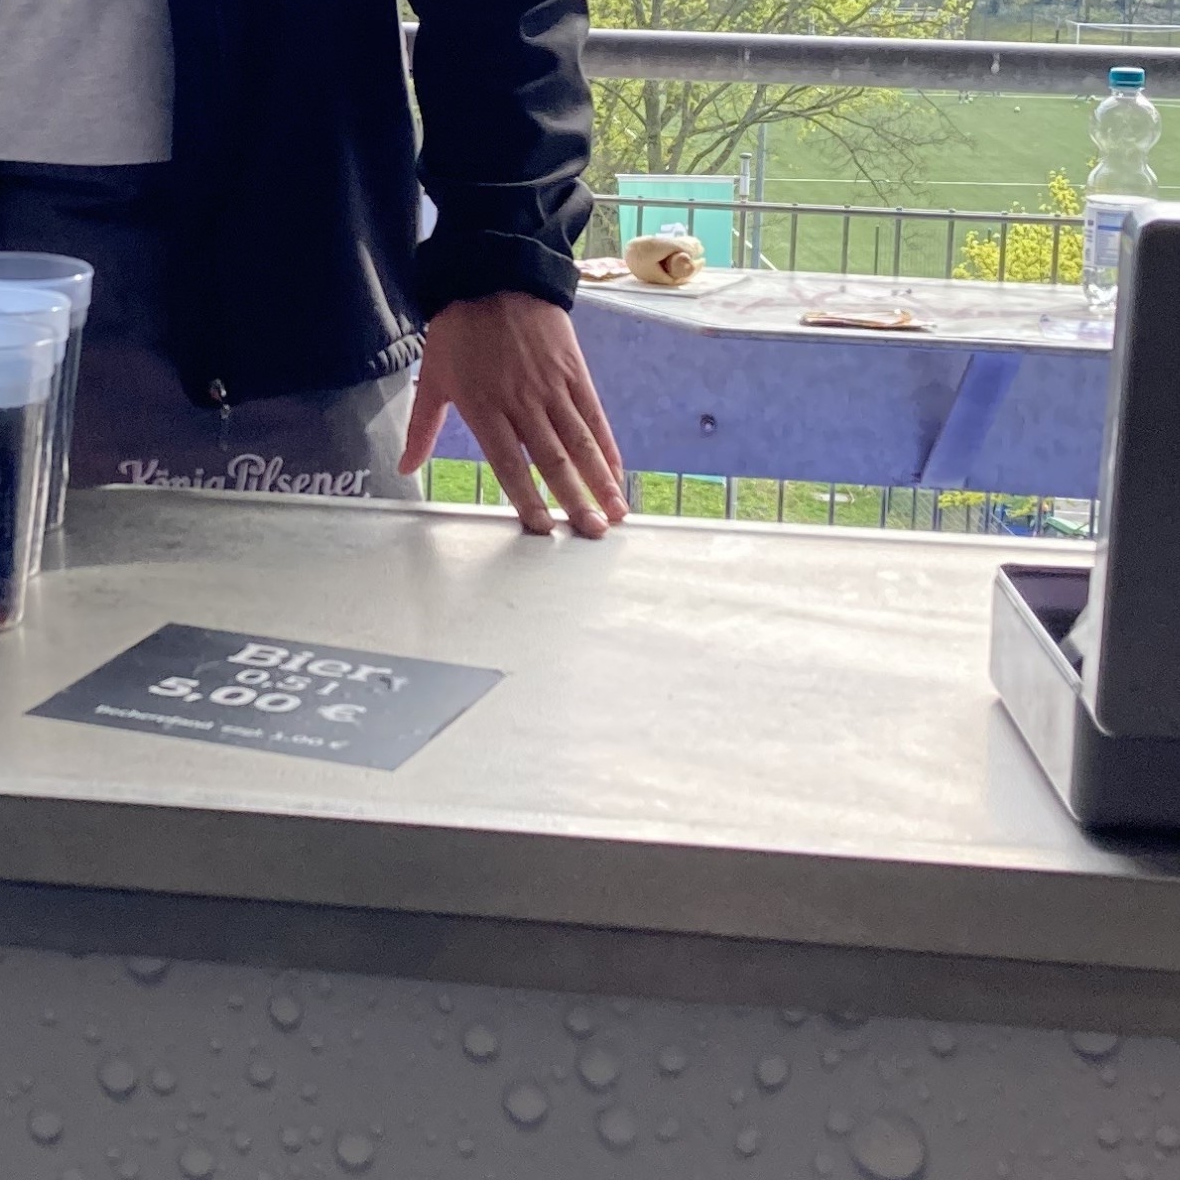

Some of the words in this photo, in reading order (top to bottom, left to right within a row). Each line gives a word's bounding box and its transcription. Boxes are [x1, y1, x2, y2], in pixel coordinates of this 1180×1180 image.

[227, 453, 370, 495] Pilsener
[227, 643, 393, 682] Bier
[235, 668, 313, 692] 0,5
[148, 676, 302, 713] 5,00
[318, 703, 368, 723] €
